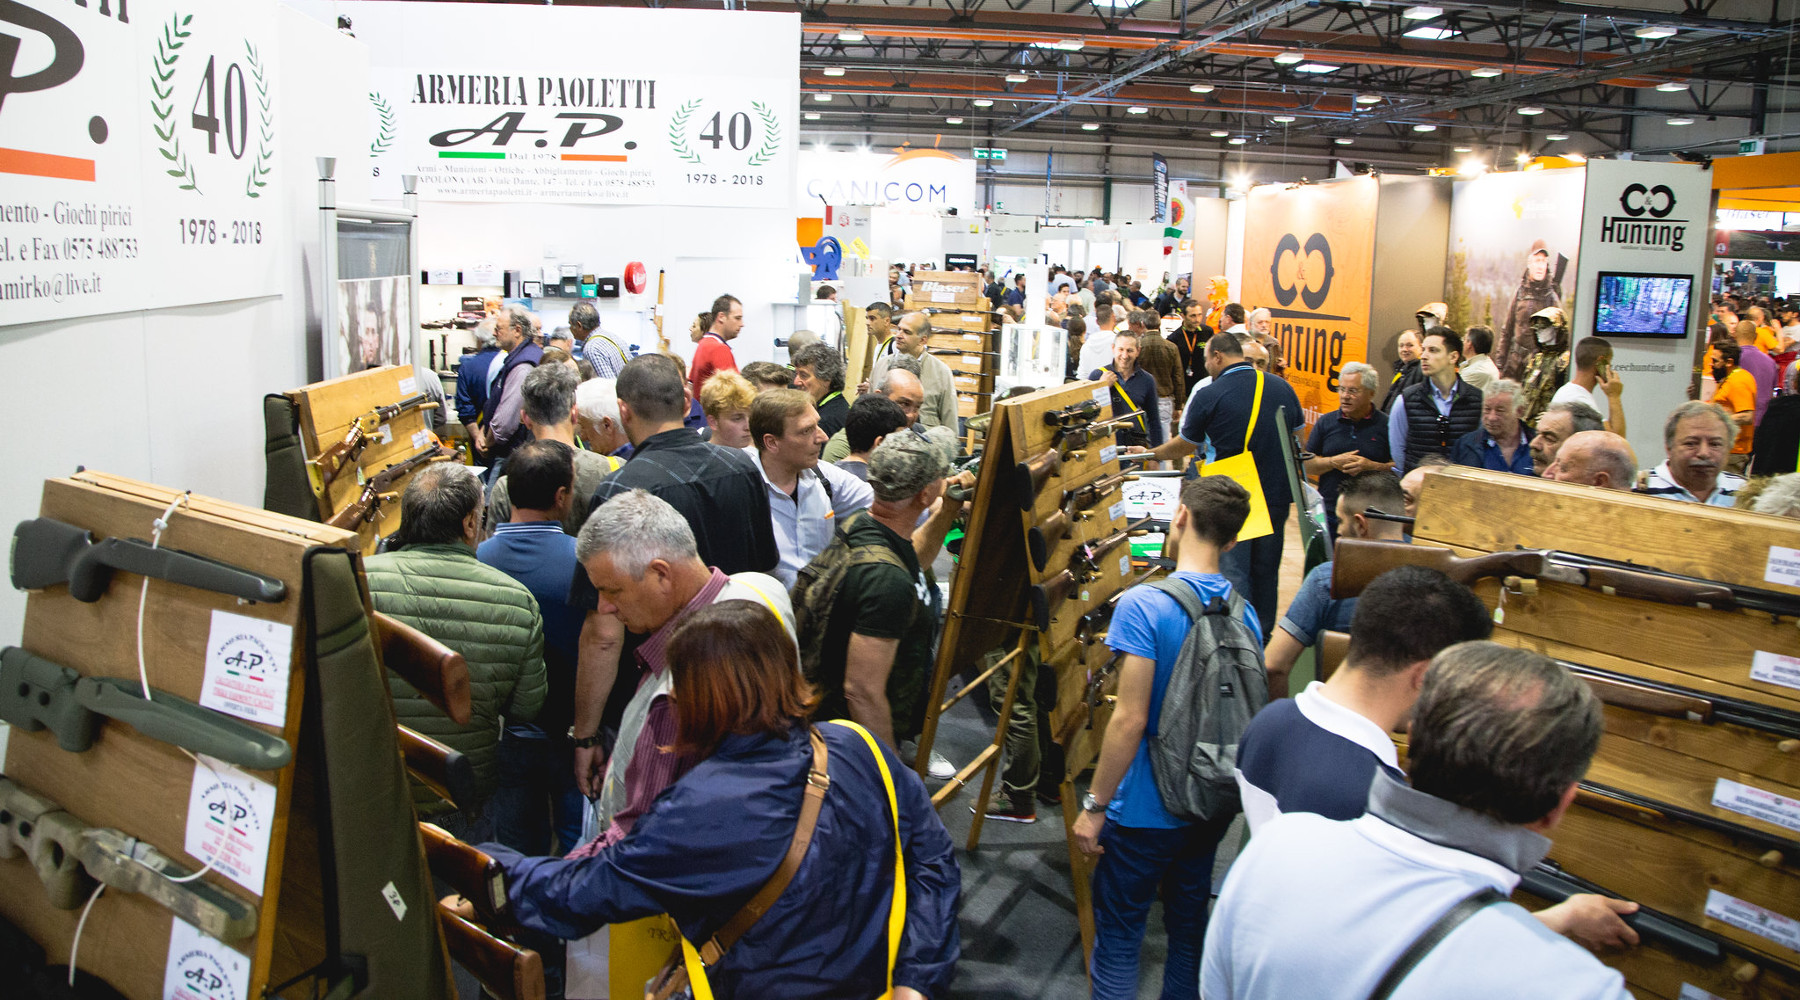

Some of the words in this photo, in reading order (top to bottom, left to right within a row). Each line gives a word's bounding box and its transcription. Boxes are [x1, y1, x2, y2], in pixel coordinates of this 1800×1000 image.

[411, 73, 528, 106] ARMERIA
[538, 77, 656, 109] PAOLETTI
[192, 55, 247, 160] 40
[429, 111, 637, 149] A.P.
[699, 111, 752, 150] 40
[509, 152, 528, 160] Dal
[532, 153, 557, 161] 1978
[417, 164, 437, 173] Armi
[445, 165, 486, 174] Munizioni
[494, 166, 526, 175] Ottiche
[534, 167, 592, 176] Abbigliamento
[600, 168, 628, 177] Giochi
[629, 169, 652, 179] pirici
[418, 176, 465, 185] APOLONA
[490, 176, 511, 185] Viale
[588, 179, 603, 187] Fax
[686, 173, 717, 184] 1978
[732, 174, 764, 186] 2018
[807, 179, 946, 203] CANICOM
[54, 201, 97, 225] Giochi
[100, 204, 132, 232] pirici
[180, 218, 217, 245] 1978
[232, 220, 262, 245] 2018
[1600, 216, 1689, 252] Hunting
[20, 244, 28, 261] e
[33, 237, 59, 260] Fax
[63, 238, 94, 260] 0575
[97, 238, 139, 259] 488753
[921, 281, 969, 293] Blaser
[224, 650, 265, 674] A.P.
